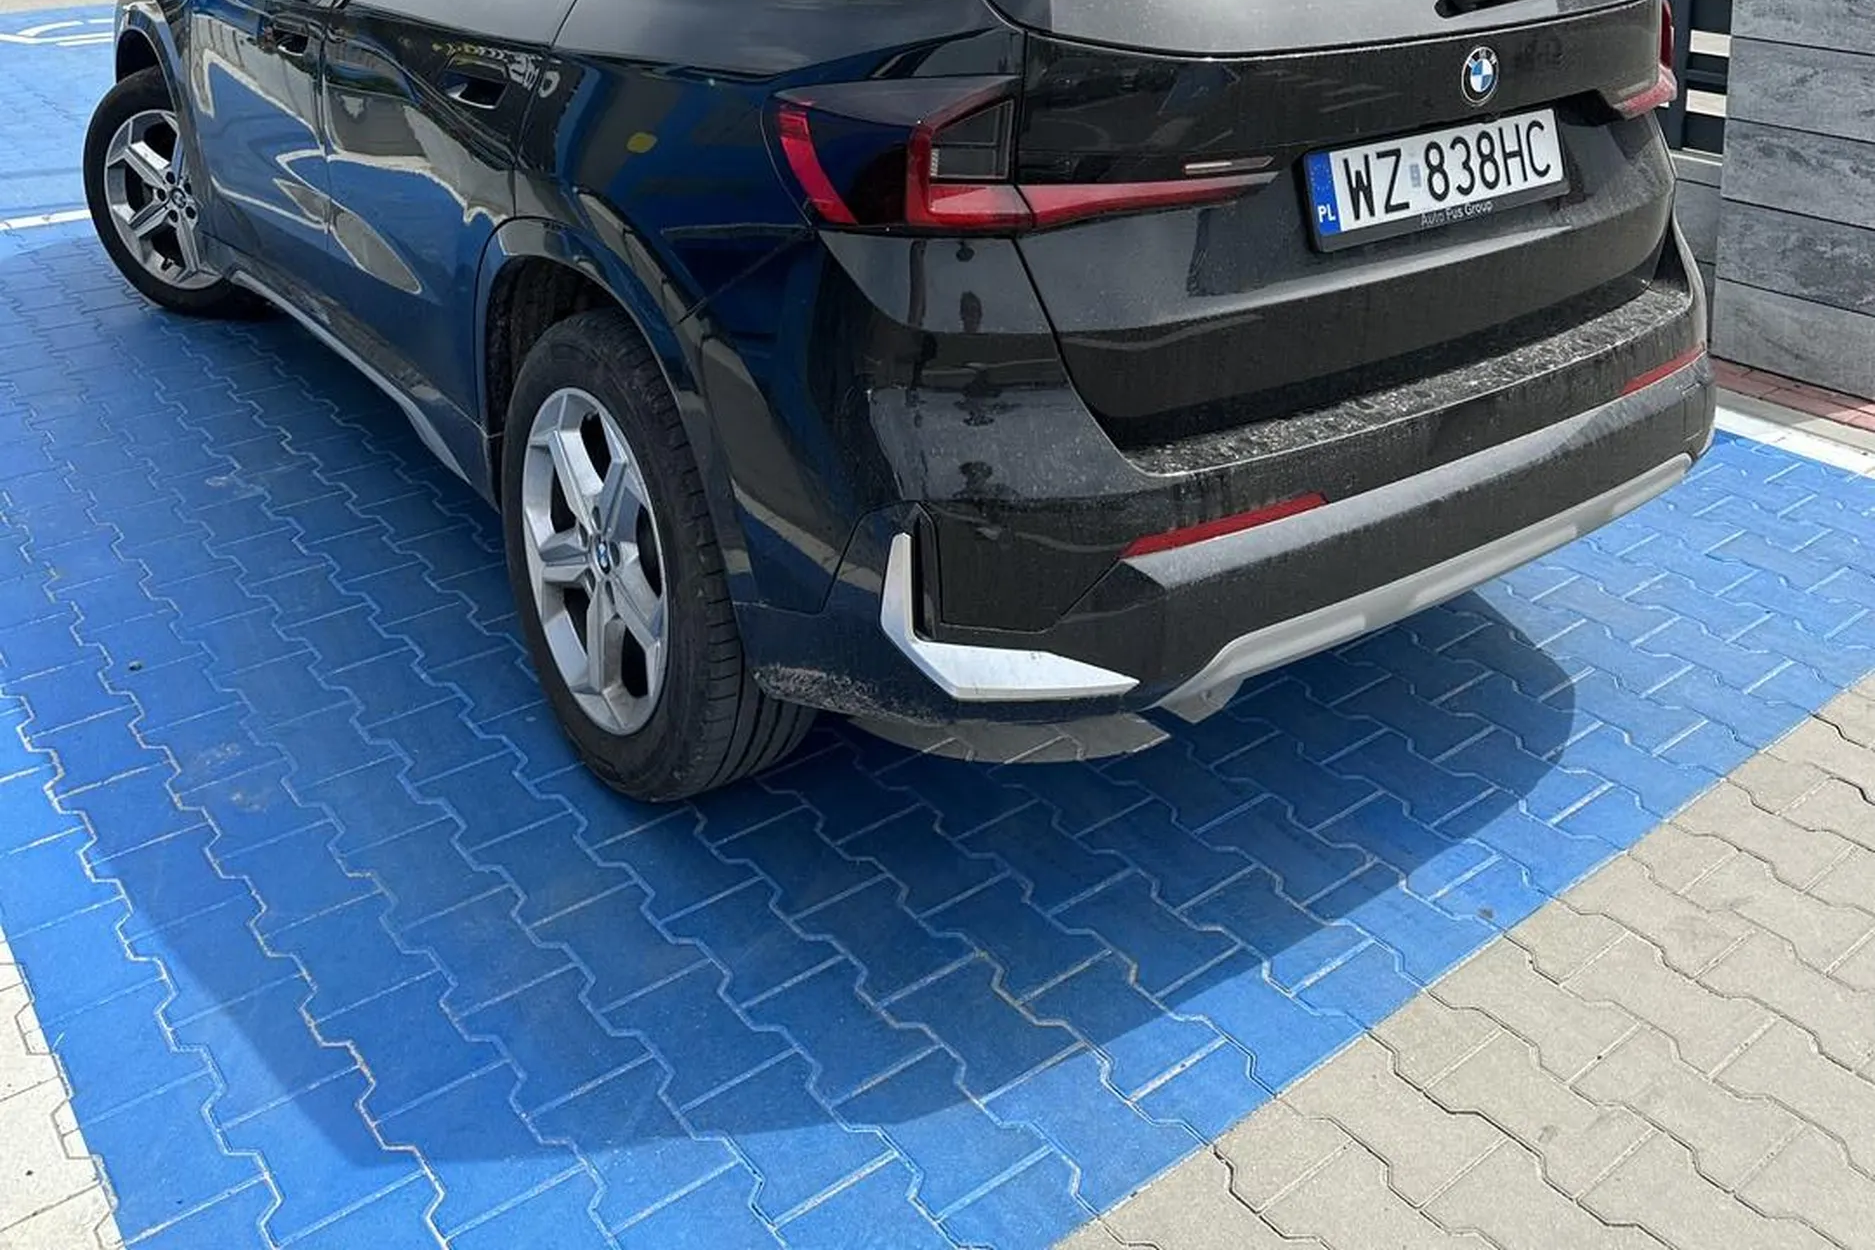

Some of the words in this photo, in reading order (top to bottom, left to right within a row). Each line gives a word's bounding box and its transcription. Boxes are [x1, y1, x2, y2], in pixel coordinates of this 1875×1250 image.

[1342, 148, 1411, 221] WZ
[1424, 120, 1552, 202] 838HC
[1318, 205, 1336, 224] PL
